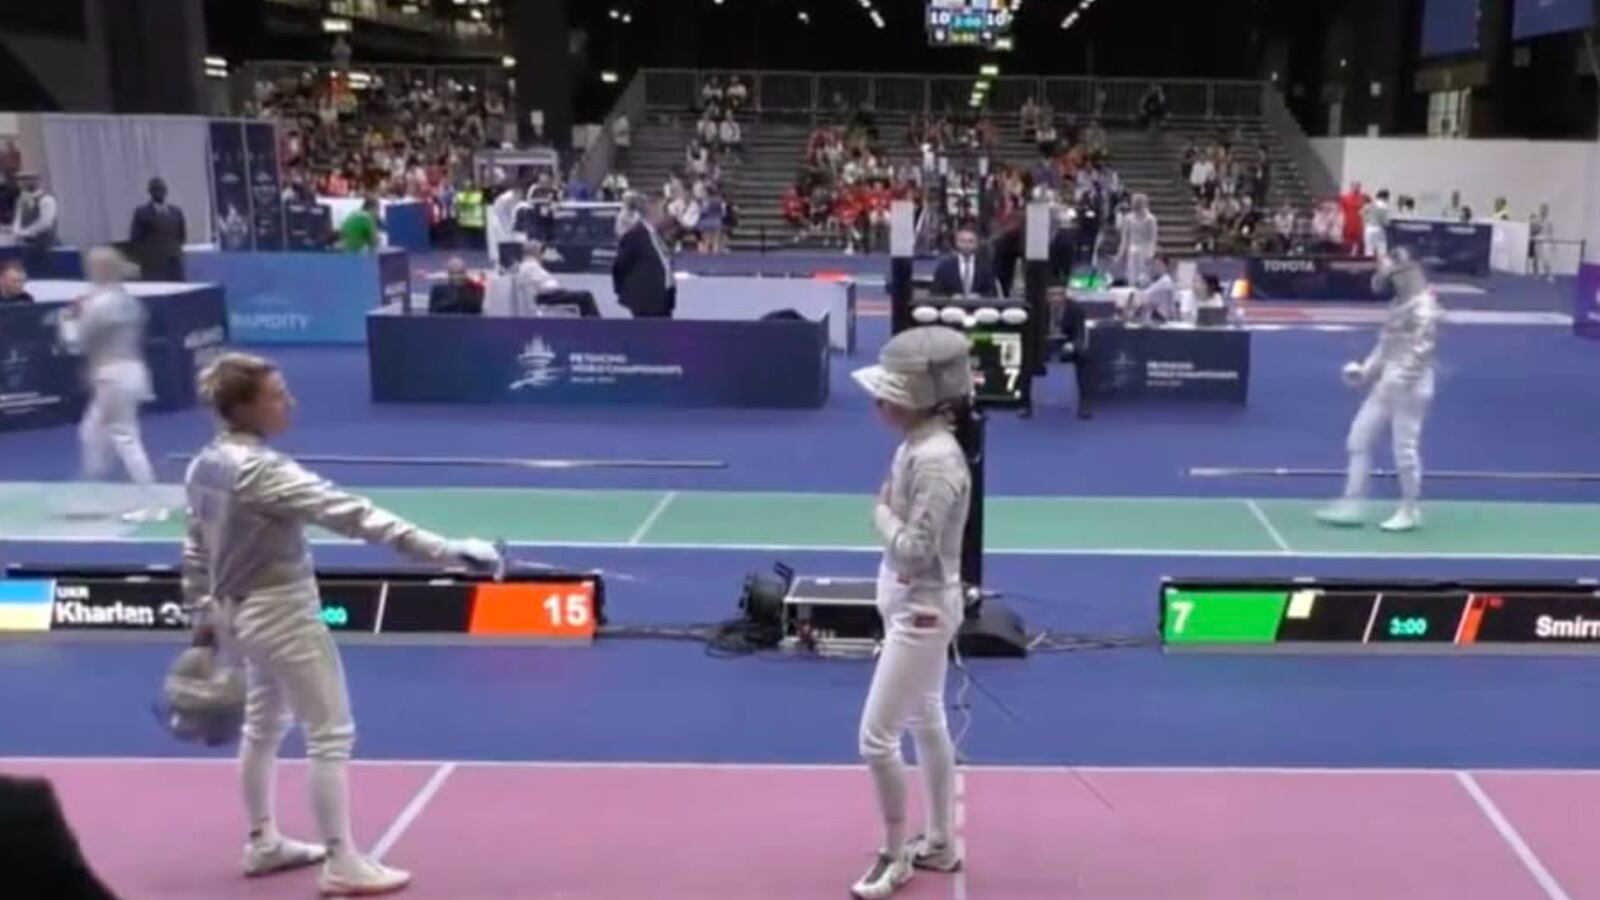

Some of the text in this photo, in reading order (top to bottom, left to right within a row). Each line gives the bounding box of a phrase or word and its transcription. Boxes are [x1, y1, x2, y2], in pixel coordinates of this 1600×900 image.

[1263, 260, 1315, 273] TOYOTA
[1004, 368, 1020, 392] 7
[57, 601, 154, 625] Kharlan
[543, 594, 587, 626] 15
[1171, 601, 1195, 634] 7
[1389, 617, 1428, 636] 3:00
